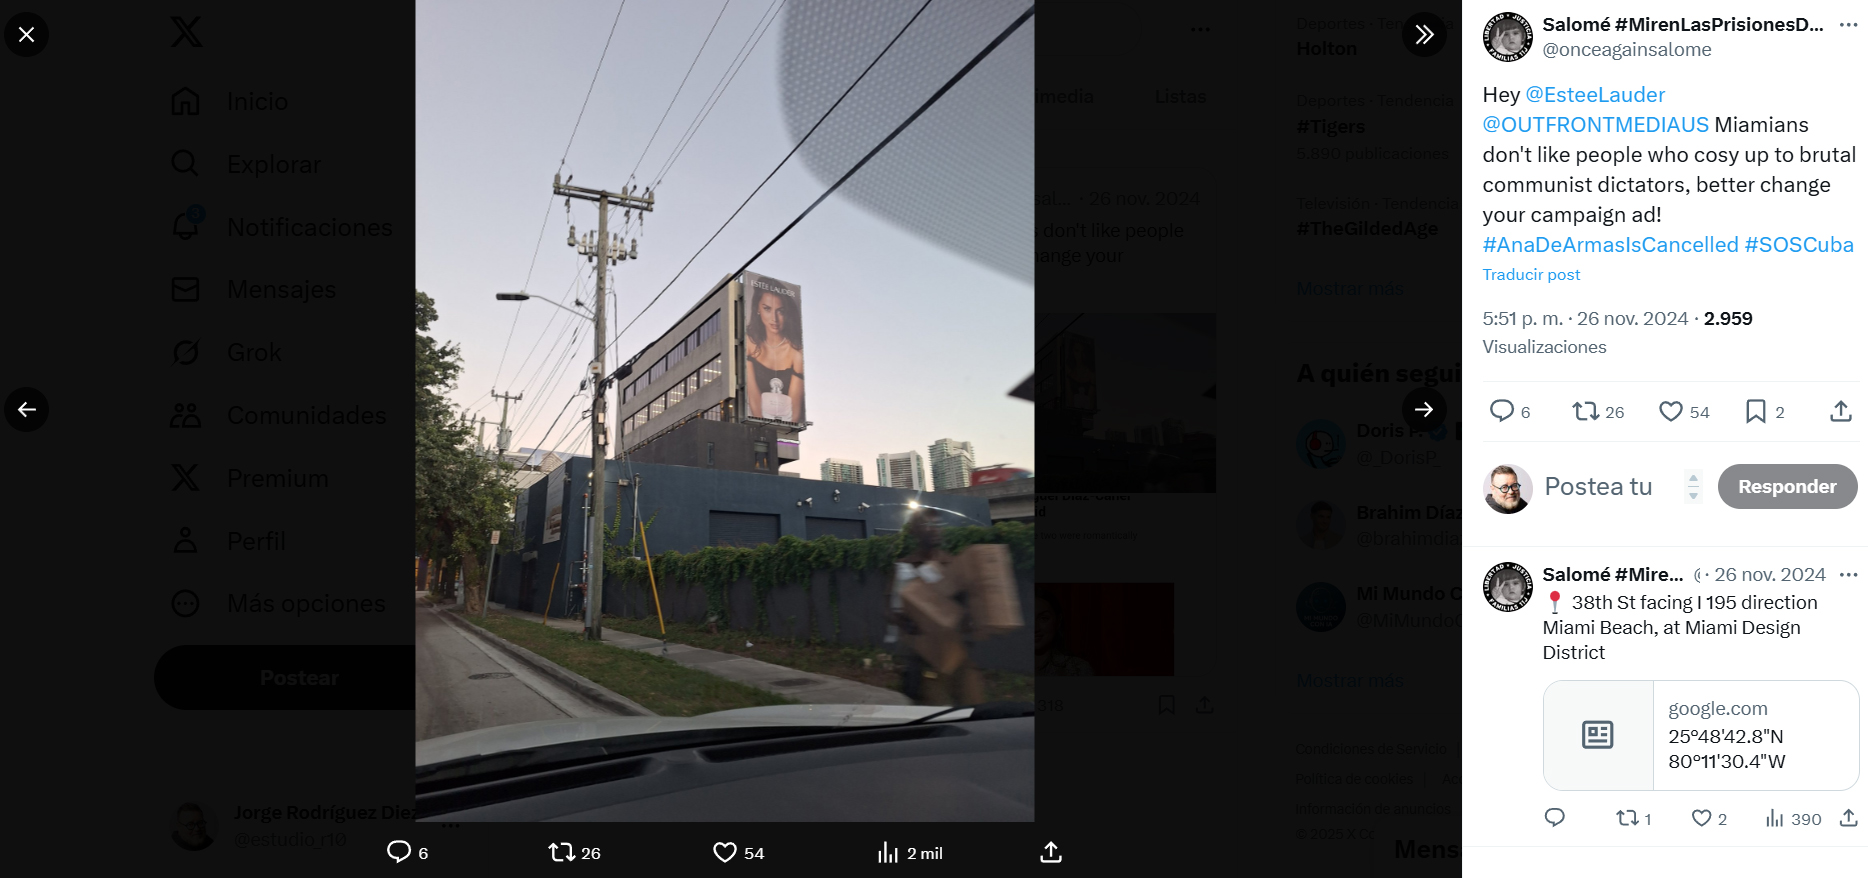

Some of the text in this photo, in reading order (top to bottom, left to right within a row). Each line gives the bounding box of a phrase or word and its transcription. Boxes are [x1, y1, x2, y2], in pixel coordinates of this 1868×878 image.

[1298, 18, 1365, 32] Deportes
[1484, 14, 1504, 41] LIBERTAD
[1512, 15, 1532, 40] JUSTICIA
[1543, 17, 1611, 31] Salomé
[1297, 41, 1357, 55] Holton
[1543, 42, 1711, 60] @onceagainsalome
[229, 92, 288, 110] Inicio
[1156, 88, 1206, 103] Listas
[1298, 94, 1453, 109] Deportes Tendencia
[1484, 86, 1666, 106] Hey @EsteeLauder
[1297, 119, 1365, 137] #Tigers
[1483, 116, 1808, 132] @OUTFRONTMEDIAUS Miamians
[1297, 147, 1448, 162] 5.890 publicaciones
[1483, 146, 1855, 166] don't like people who cosy up to brutal
[229, 154, 321, 178] Explorar
[1483, 176, 1830, 196] communist dictators, better change
[1090, 192, 1111, 205] 26
[1117, 195, 1149, 205] nov.
[1156, 192, 1200, 205] 2024
[1296, 197, 1458, 209] Televisión Tendencia
[1483, 206, 1661, 226] your campaign ad!
[229, 217, 392, 236] Notificaciones
[1044, 223, 1086, 237] don't
[1092, 223, 1120, 237] like
[1126, 223, 1183, 241] people
[1297, 221, 1438, 239] #TheGildedAge
[1483, 236, 1853, 252] #AnaDeArmasIsCancelled #SOSCuba
[1086, 252, 1124, 266] your
[1482, 268, 1581, 283] Traducir post
[229, 280, 336, 303] Mensajes
[1298, 281, 1403, 296] Mostrar más
[1483, 312, 1753, 329] 5:51 p. m. 26 nov. 2024 2.959
[228, 342, 282, 361] Grok
[1482, 339, 1607, 353] Visualizaciones
[1297, 364, 1315, 382] A
[1321, 362, 1389, 387] quién
[228, 405, 386, 424] Comunidades
[1521, 407, 1530, 418] 6
[1606, 407, 1624, 418] 26
[1690, 407, 1710, 418] 54
[1776, 407, 1784, 418] 2
[1357, 423, 1404, 437] Doris
[1357, 450, 1441, 467] @_DorisP_
[229, 469, 328, 487] Premium
[1546, 477, 1651, 495] Postea tu
[1740, 479, 1837, 497] Responder
[1357, 505, 1421, 519] Brahim
[229, 531, 285, 550] Perfil
[1083, 531, 1137, 541] romantically
[1484, 564, 1504, 591] LIBERTAD
[1512, 565, 1532, 590] JUSTICIA
[1543, 567, 1611, 581] Salomé
[1715, 568, 1736, 581] 26
[1743, 571, 1776, 581] nov.
[1781, 568, 1826, 581] 2024
[1357, 586, 1378, 600] Mi
[1383, 586, 1445, 600] Mundo
[229, 593, 385, 617] Más opciones
[1572, 595, 1612, 609] 38th
[1617, 596, 1636, 609] St
[1640, 595, 1693, 613] facing
[1706, 596, 1736, 609] 195
[1742, 595, 1817, 609] direction
[1544, 620, 1800, 638] Miami Beach, at Miami Design
[1544, 645, 1605, 659] District
[261, 670, 339, 685] Postear
[1298, 673, 1403, 688] Mostrar más
[1038, 700, 1063, 711] 318
[1669, 701, 1767, 719] google.com
[1296, 743, 1446, 754] Condiciones de Servicio
[1296, 773, 1342, 784] Política
[1346, 773, 1361, 784] de
[1365, 773, 1413, 784] cookies
[234, 806, 282, 823] Jorge
[287, 805, 377, 823] Rodríguez
[1296, 803, 1451, 814] Información de anuncios
[1645, 814, 1650, 825] 1
[1718, 814, 1727, 825] 2
[1792, 814, 1821, 825] 390
[235, 832, 346, 849] @estudio_r10
[1310, 829, 1343, 839] 2025
[419, 848, 428, 859] 6
[581, 848, 601, 859] 26
[744, 848, 765, 859] 54
[907, 847, 942, 859] 2 mil
[1395, 840, 1461, 858] Mens
